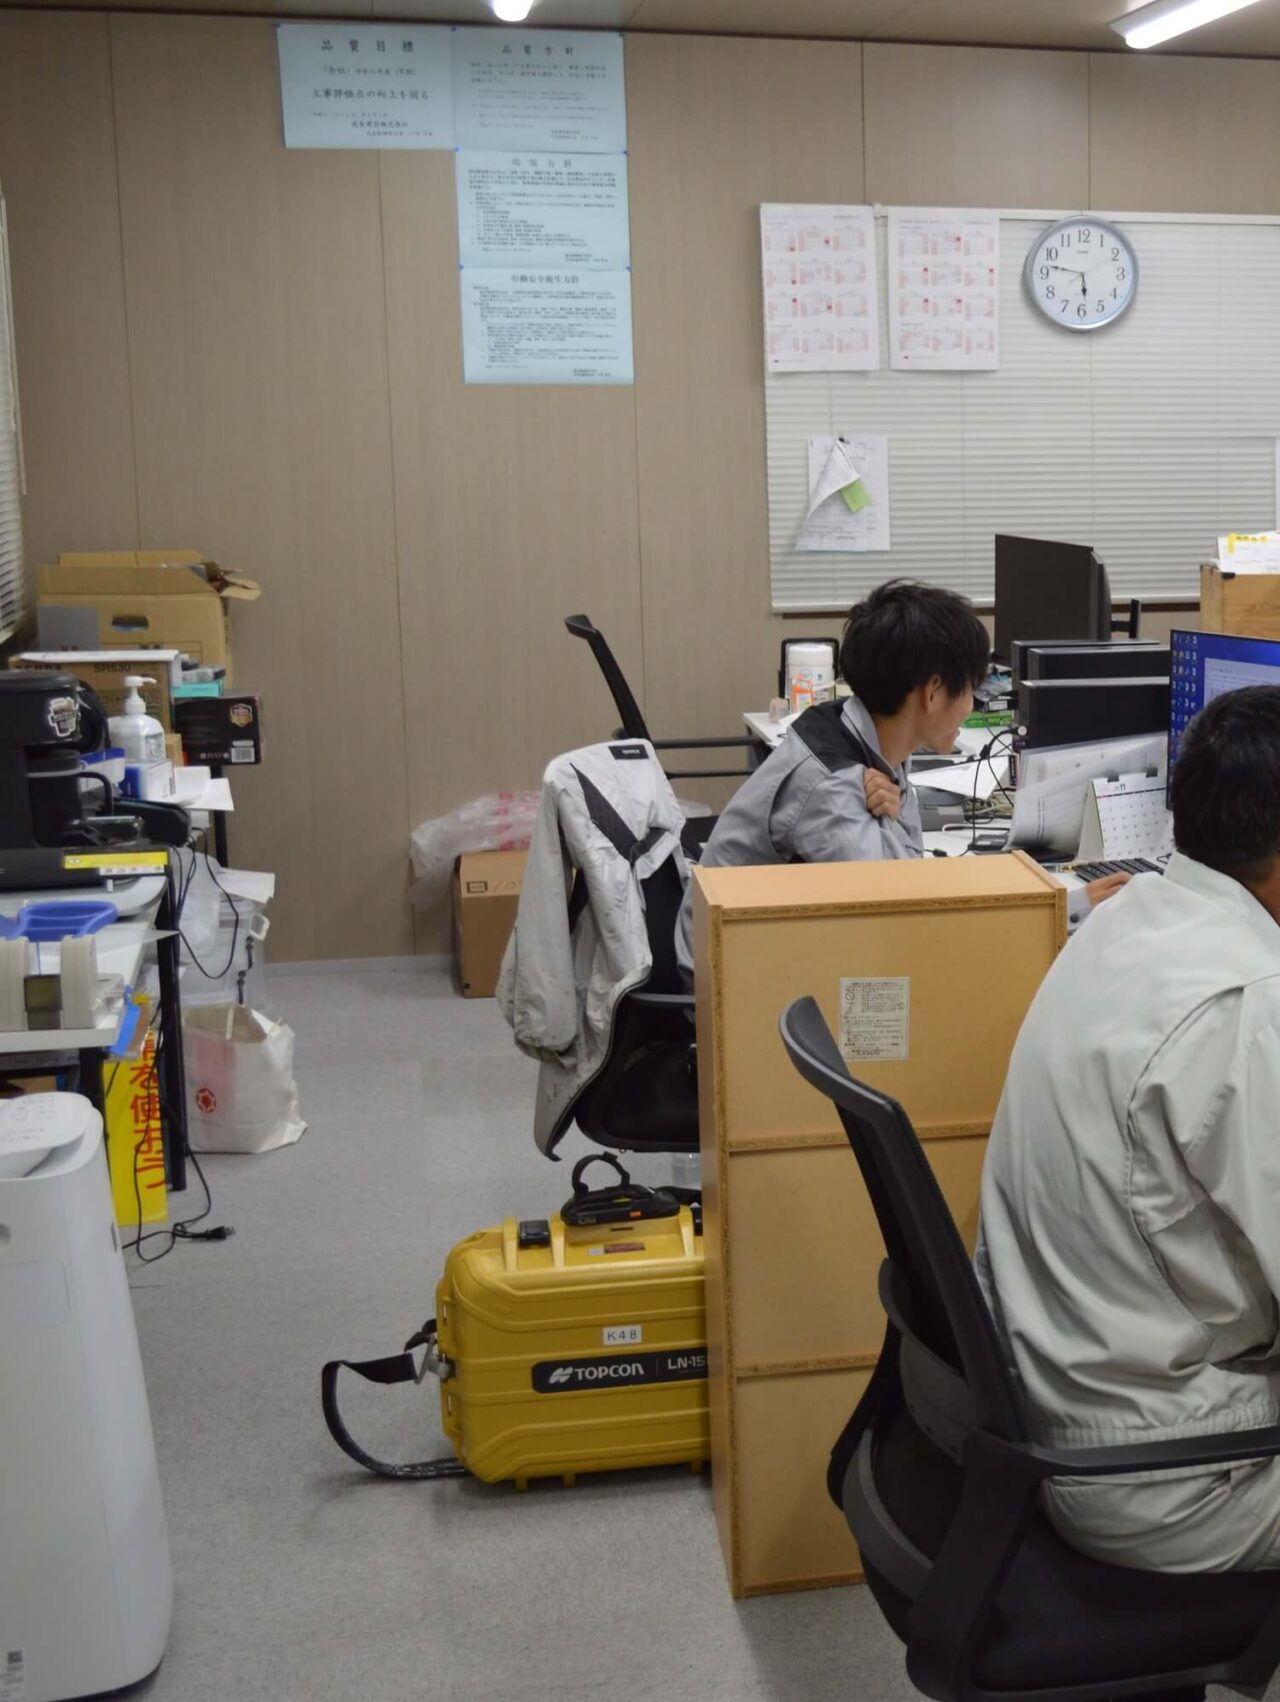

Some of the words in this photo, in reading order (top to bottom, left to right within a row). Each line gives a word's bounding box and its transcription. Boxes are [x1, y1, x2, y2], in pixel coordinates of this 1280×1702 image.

[321, 39, 415, 53] 品質目標
[1061, 233, 1071, 247] 11
[1078, 228, 1091, 243] 12
[1100, 234, 1104, 248] 1
[1046, 247, 1058, 261] 10
[1111, 247, 1120, 261] 2
[1040, 265, 1049, 280] 9
[1116, 267, 1125, 281] 3
[1046, 285, 1055, 299] 8
[1109, 287, 1117, 300] 4
[1060, 300, 1069, 313] 7
[1077, 304, 1086, 318] 6
[1096, 300, 1105, 313] 5
[608, 1328, 637, 1342] K48
[575, 1362, 645, 1381] TOPCON
